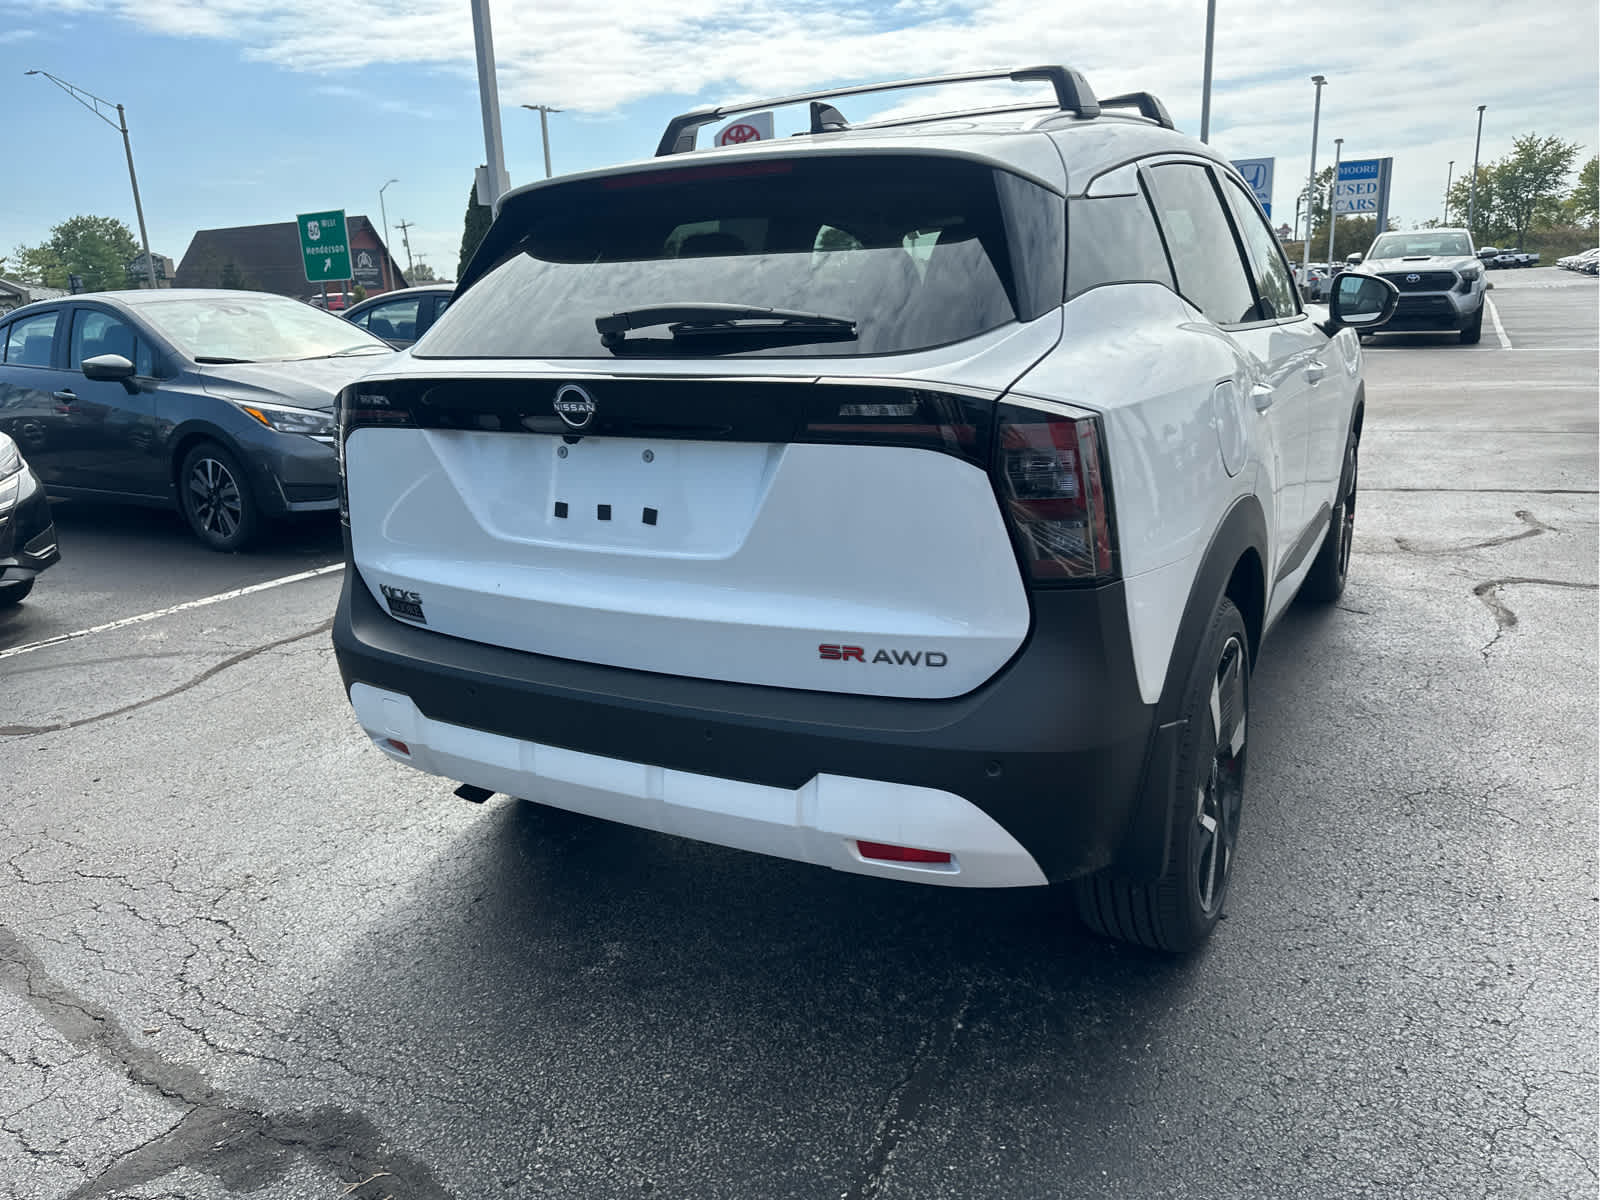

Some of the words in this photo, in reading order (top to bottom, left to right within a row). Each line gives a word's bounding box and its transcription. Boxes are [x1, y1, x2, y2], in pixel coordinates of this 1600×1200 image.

[1338, 164, 1377, 175] MOORE
[1336, 182, 1377, 196] USED
[1335, 198, 1376, 211] CARS
[306, 245, 345, 255] Henderson
[553, 402, 595, 411] NISSAN
[379, 584, 422, 604] KICKS
[818, 643, 867, 662] SR
[872, 648, 948, 667] AWD
